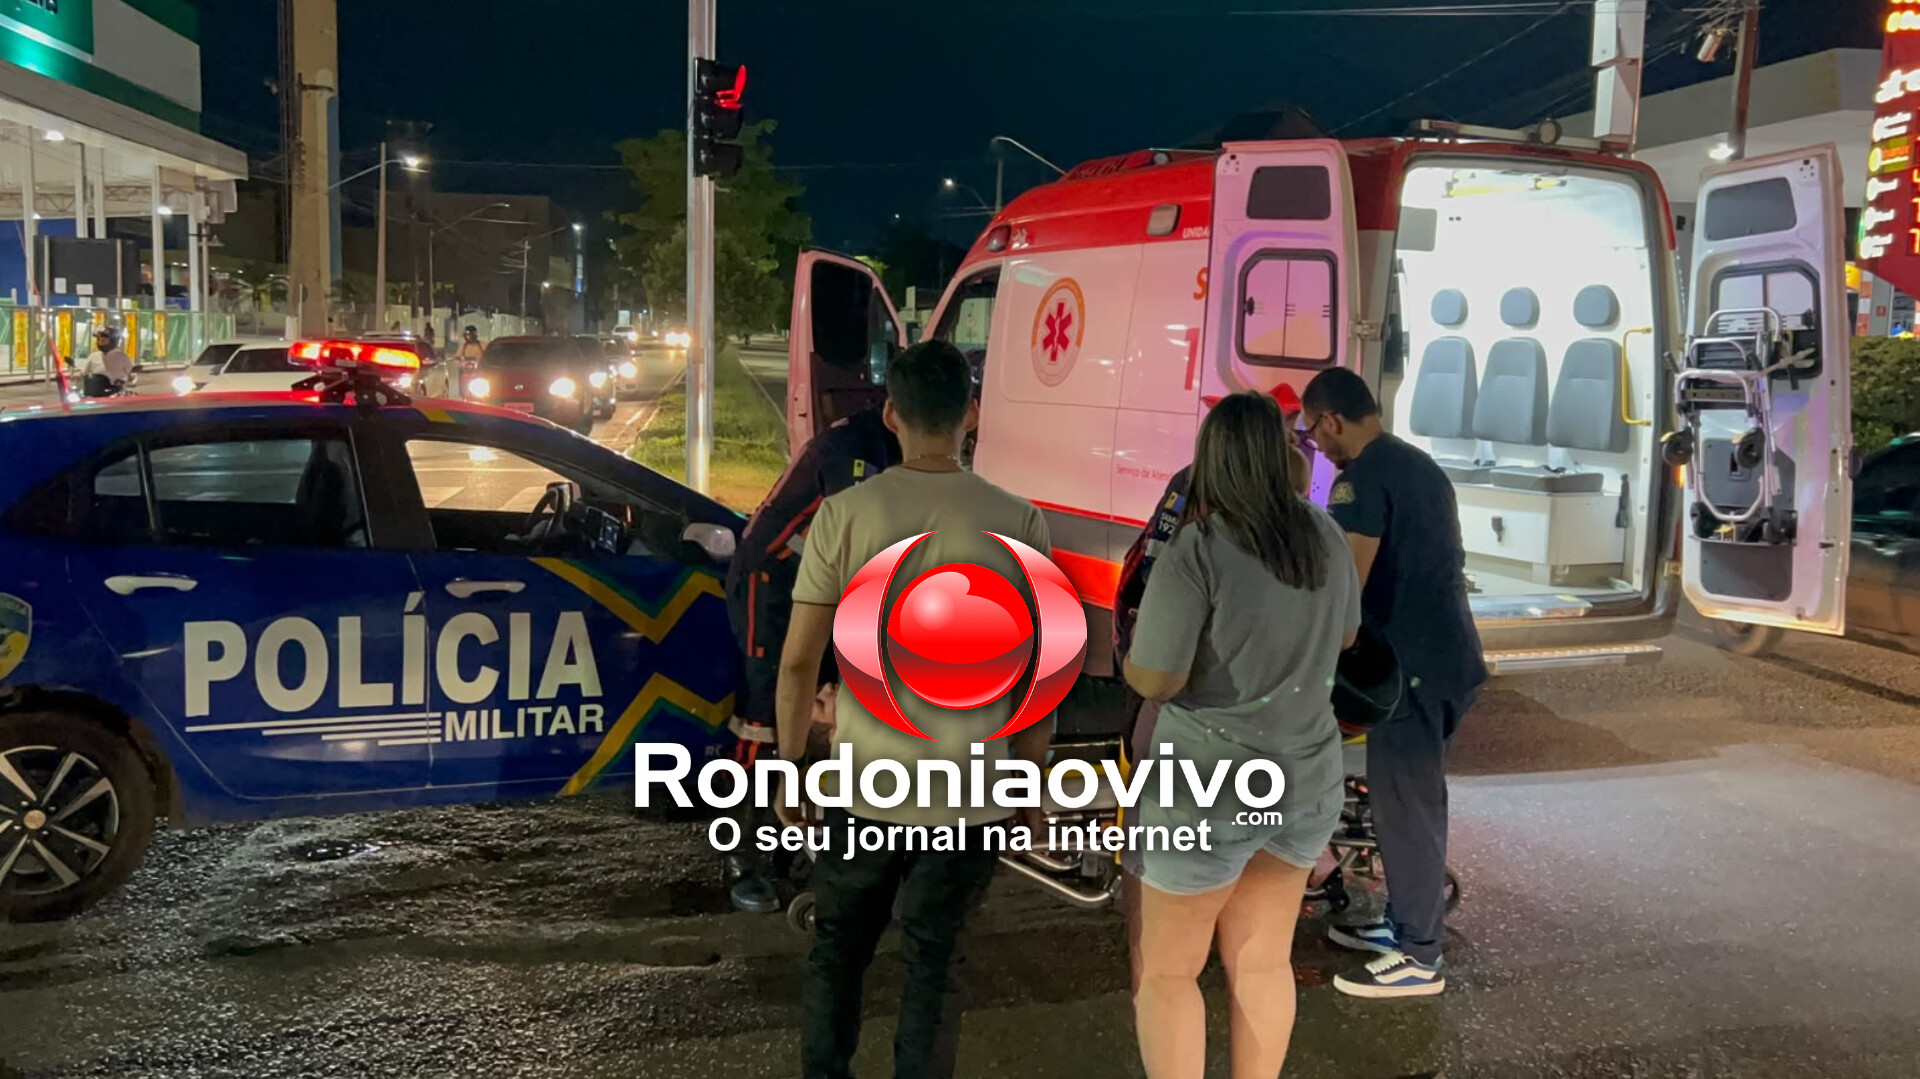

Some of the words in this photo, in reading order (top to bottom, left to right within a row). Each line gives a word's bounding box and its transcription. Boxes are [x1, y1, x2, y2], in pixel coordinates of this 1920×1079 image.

[1158, 520, 1176, 535] 192
[184, 592, 603, 717] POLÍCIA
[444, 703, 604, 742] MILITAR
